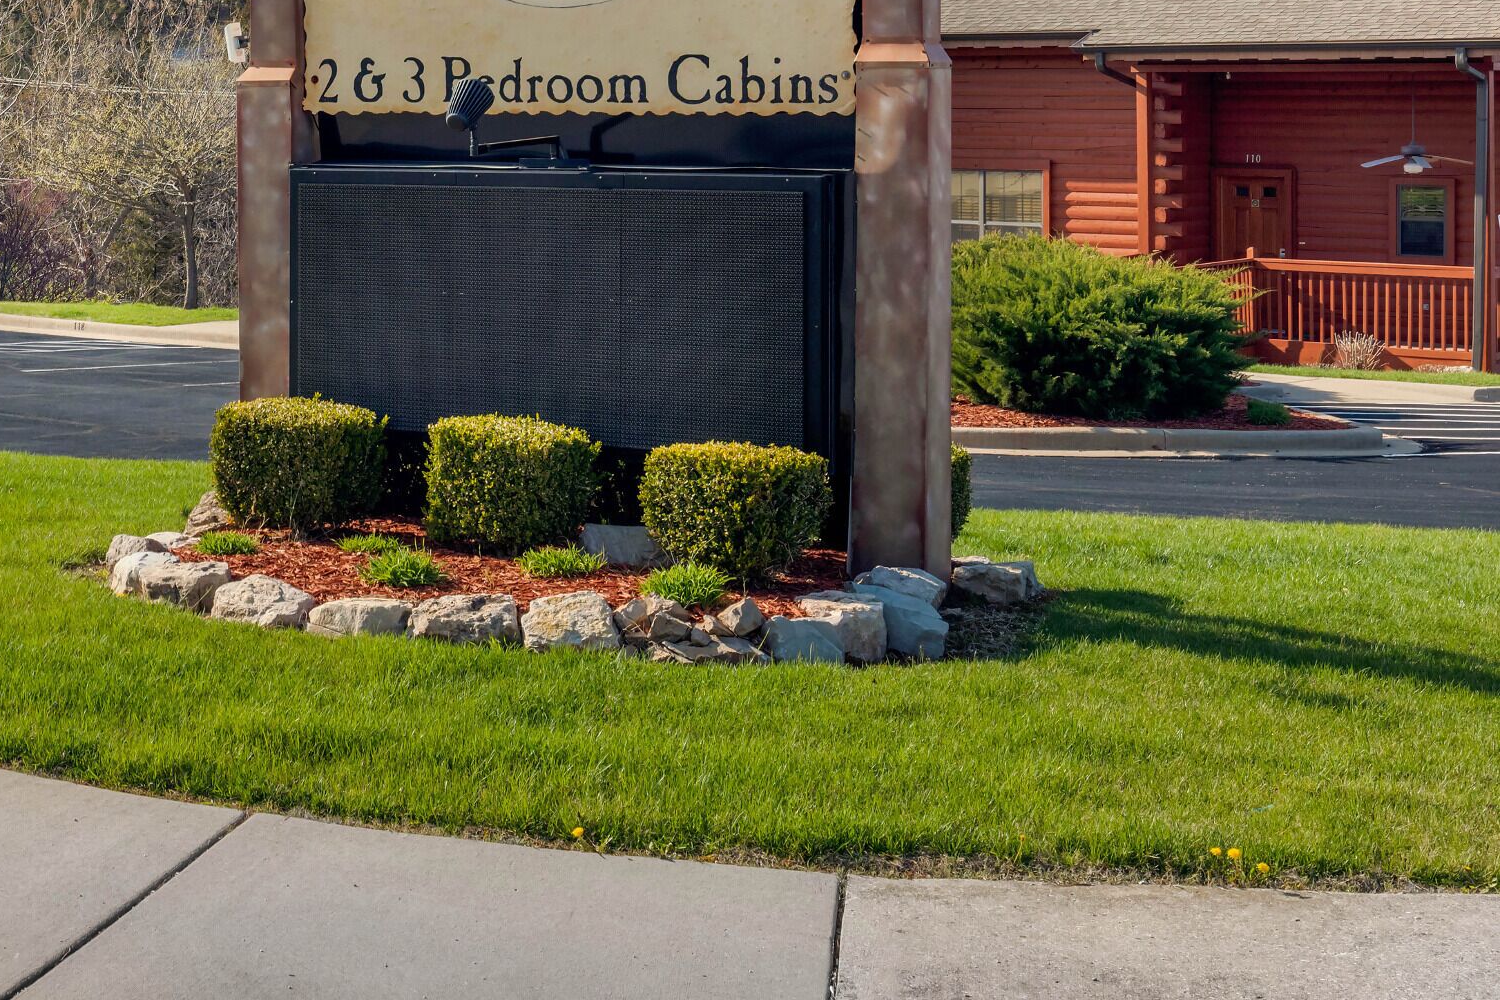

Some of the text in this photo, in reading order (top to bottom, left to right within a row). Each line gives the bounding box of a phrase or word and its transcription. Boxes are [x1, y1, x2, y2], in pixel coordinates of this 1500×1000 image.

[318, 58, 339, 103] 2
[353, 58, 386, 103] &
[402, 56, 425, 102] 3
[667, 53, 839, 105] Cabins
[1245, 154, 1261, 164] 110
